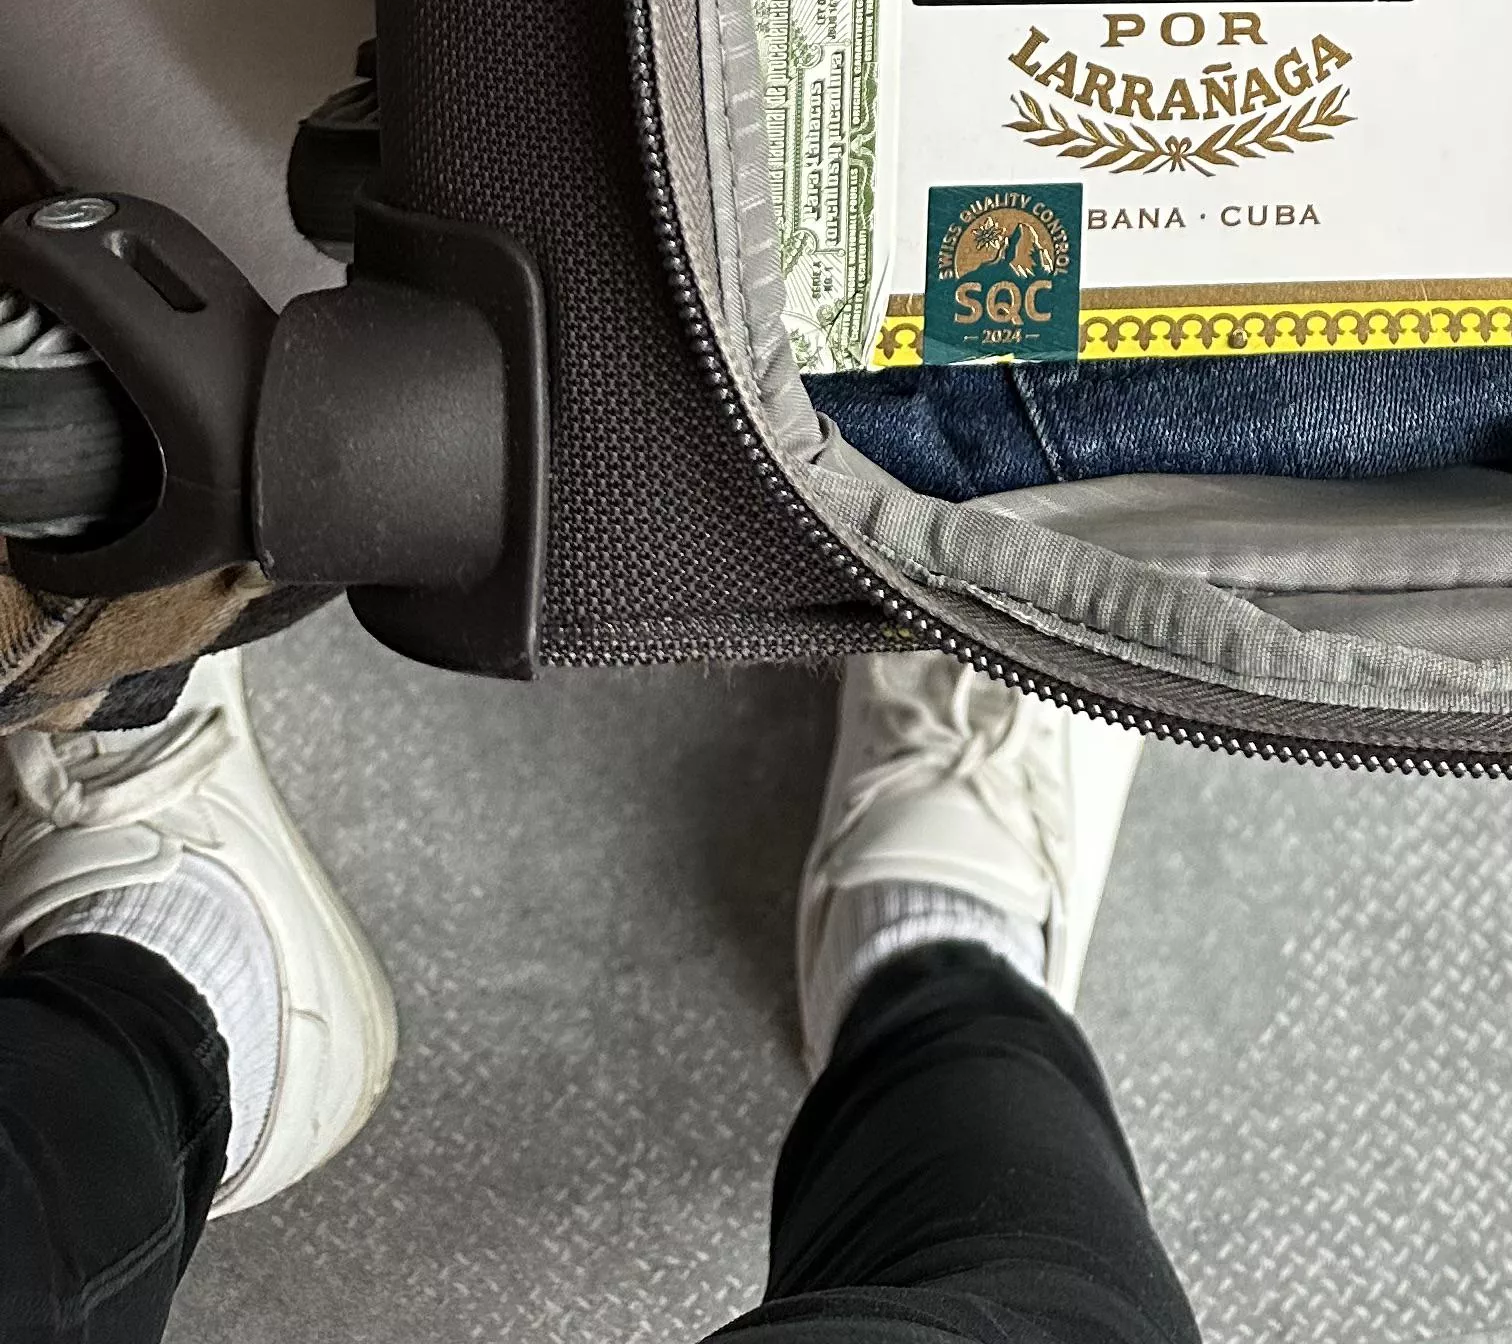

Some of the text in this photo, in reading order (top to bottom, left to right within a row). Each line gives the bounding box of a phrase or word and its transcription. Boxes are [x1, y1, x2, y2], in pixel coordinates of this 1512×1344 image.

[1100, 12, 1268, 48] POR
[764, 86, 788, 103] de
[1008, 25, 1353, 121] LARRAÑAGA
[827, 51, 844, 142] picadura
[802, 81, 821, 221] Para Tabacos
[938, 192, 1071, 281] SWISS QUALITY CONTROL
[1088, 204, 1321, 230] BANA CUBA
[954, 280, 1053, 326] SQC
[981, 329, 1022, 344] 2024
